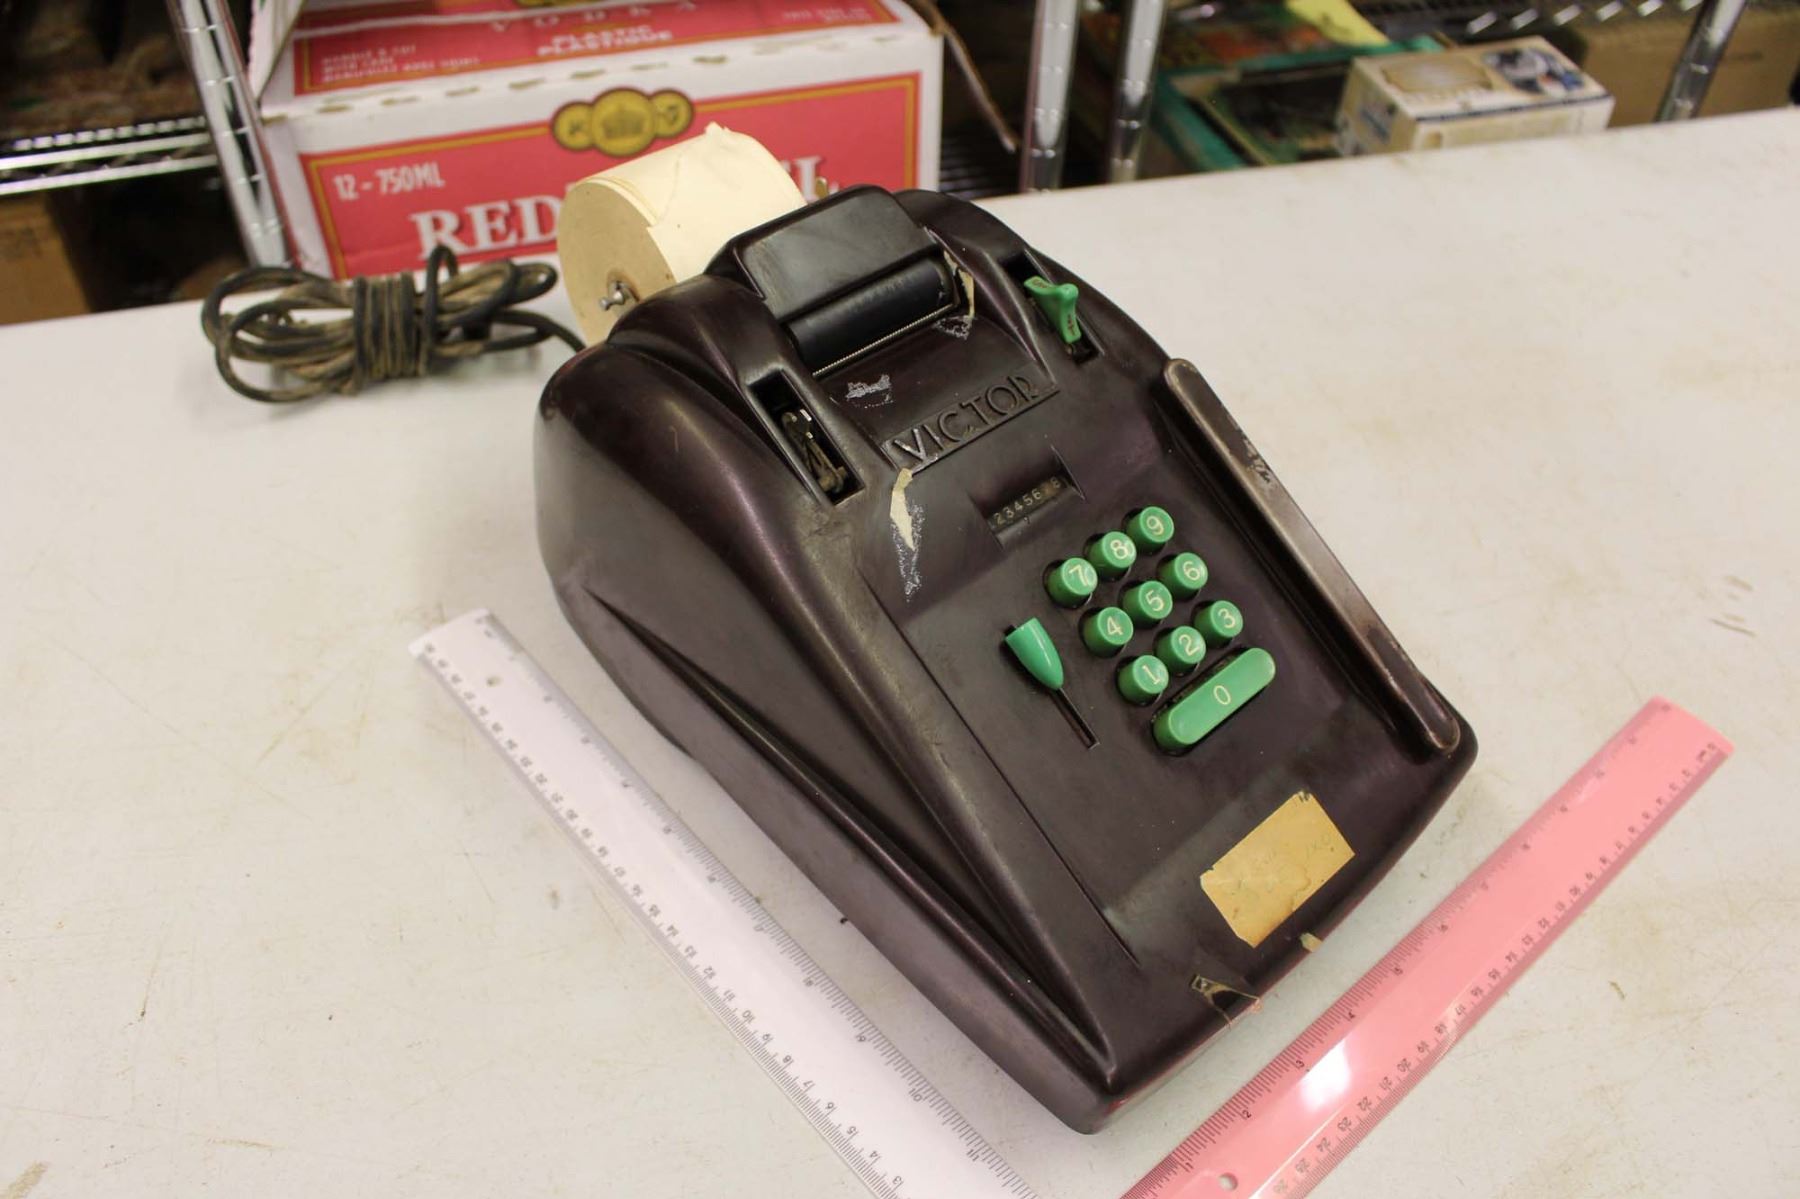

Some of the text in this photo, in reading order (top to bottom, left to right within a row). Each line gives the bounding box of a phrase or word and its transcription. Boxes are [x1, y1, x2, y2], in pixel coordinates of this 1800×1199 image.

[409, 194, 561, 261] RED
[894, 376, 1039, 461] VICTOR
[1069, 515, 1164, 586] 7 8 9
[1107, 561, 1200, 636] 4 5 6
[1142, 608, 1236, 685] 1 2 3
[1213, 685, 1231, 705] 0
